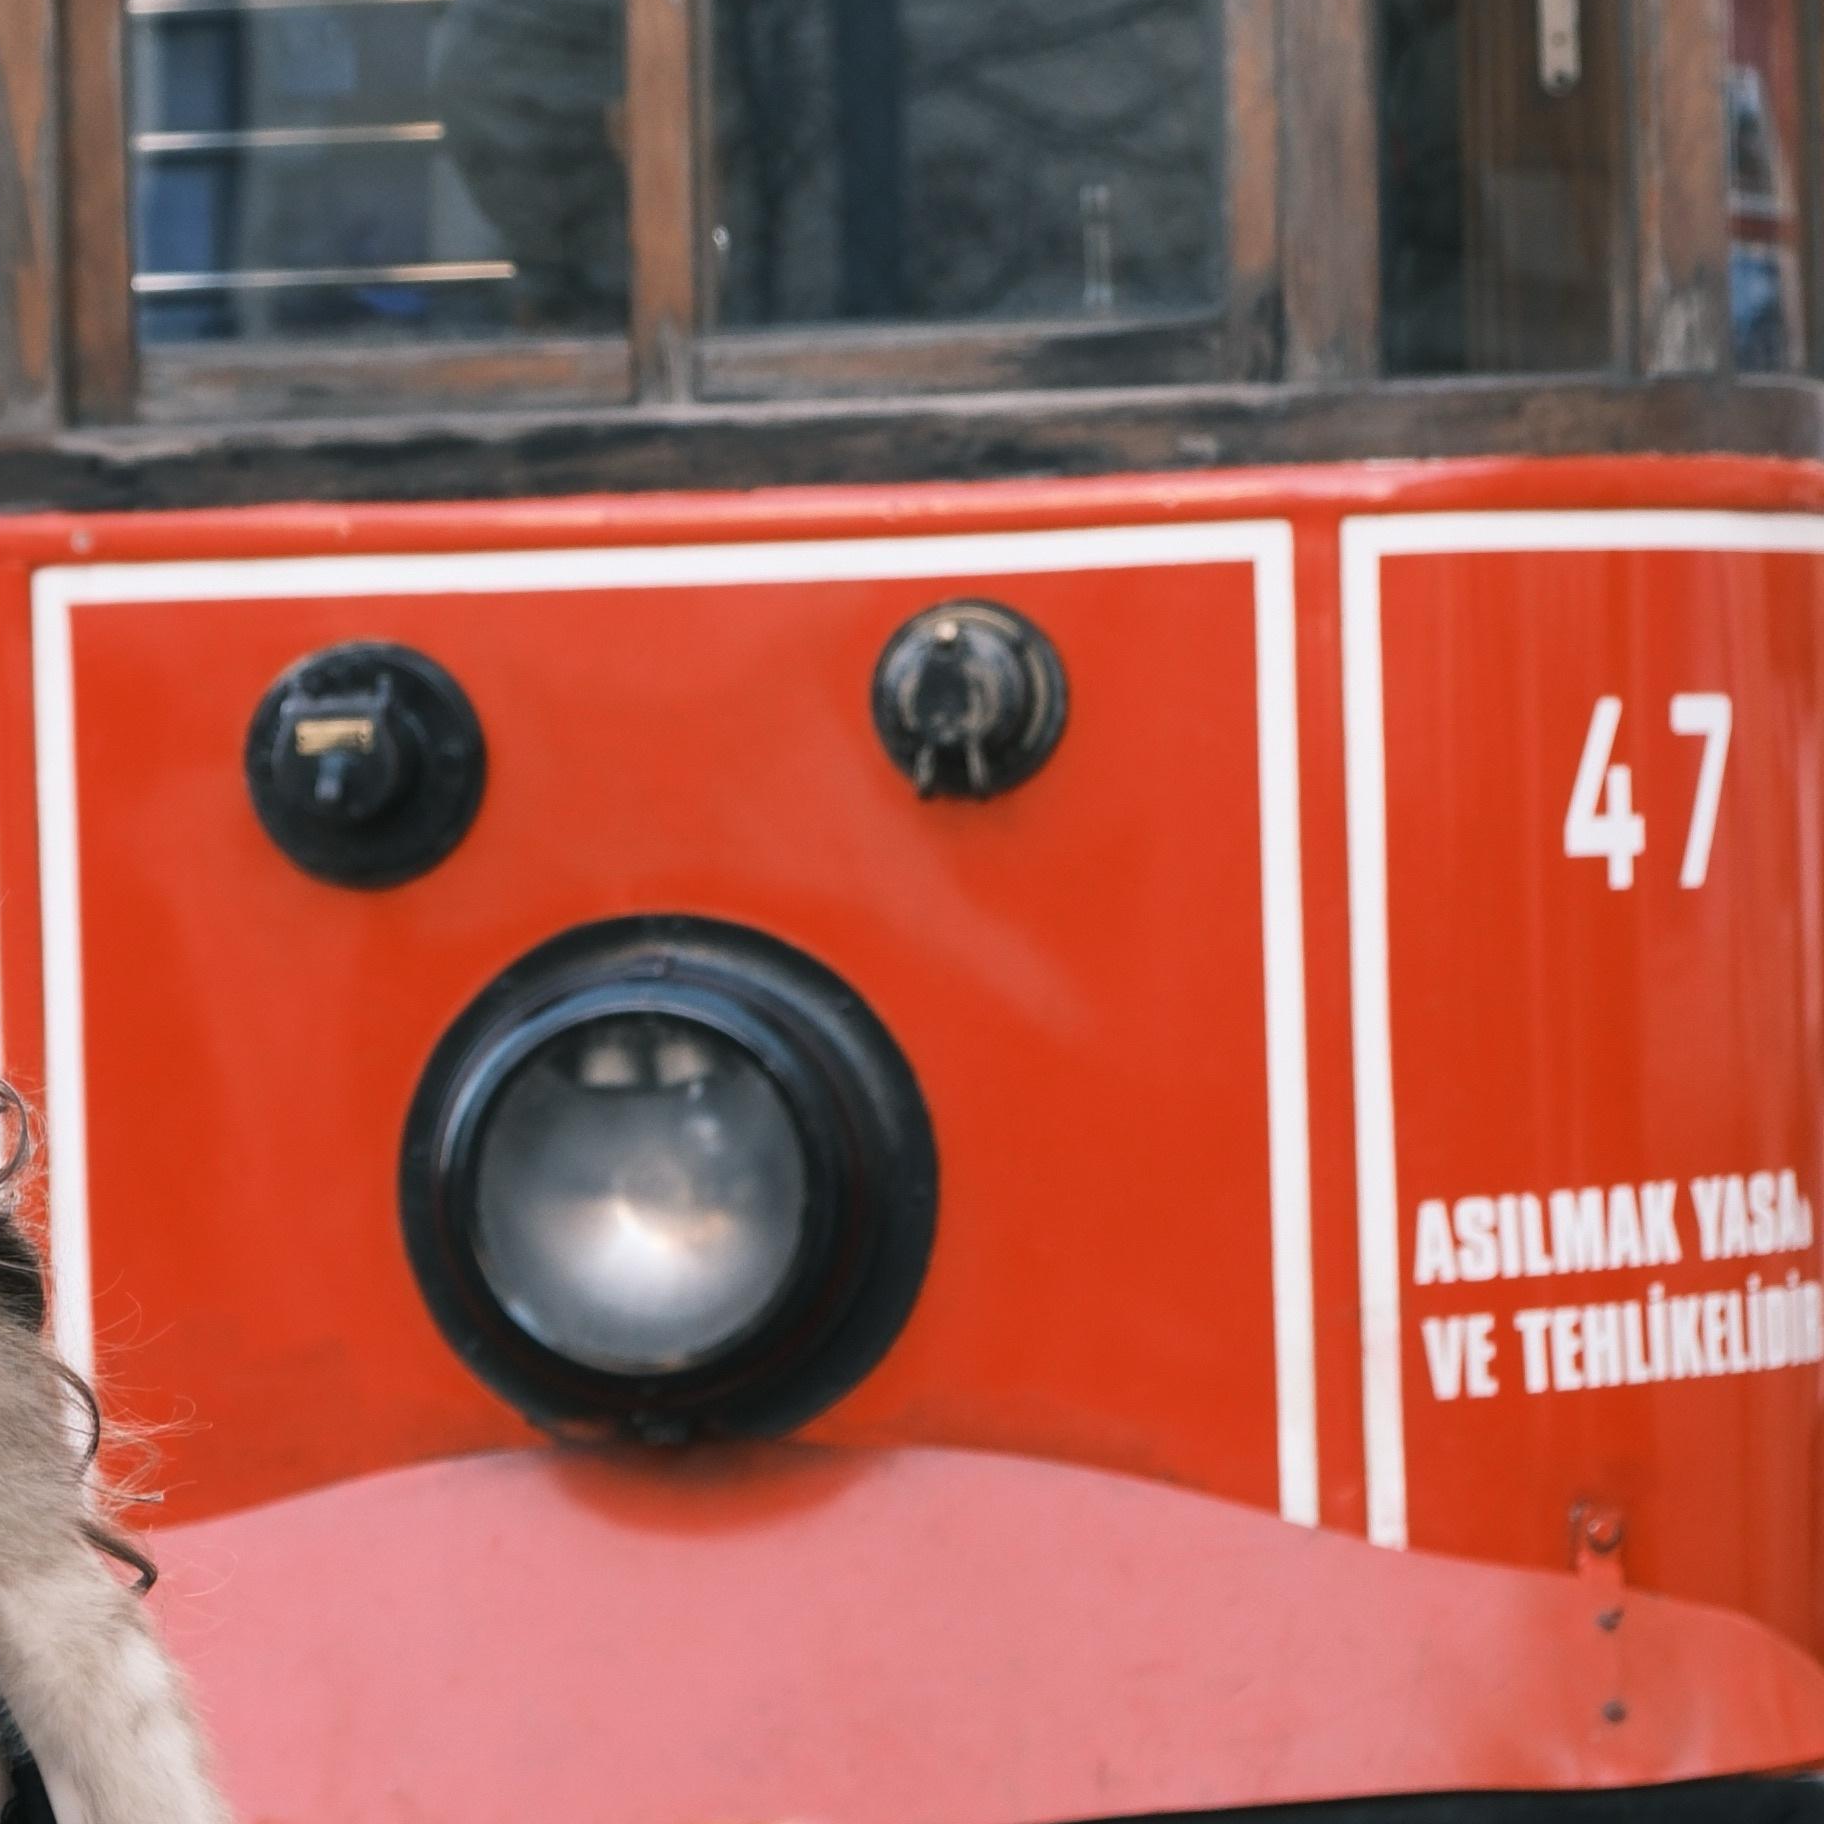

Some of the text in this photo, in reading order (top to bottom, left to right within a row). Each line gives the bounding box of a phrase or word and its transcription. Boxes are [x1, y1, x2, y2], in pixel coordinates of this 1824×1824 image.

[1563, 691, 1733, 891] 47
[1413, 1178, 1683, 1286] ASILMAK
[1420, 1312, 1500, 1402] VE
